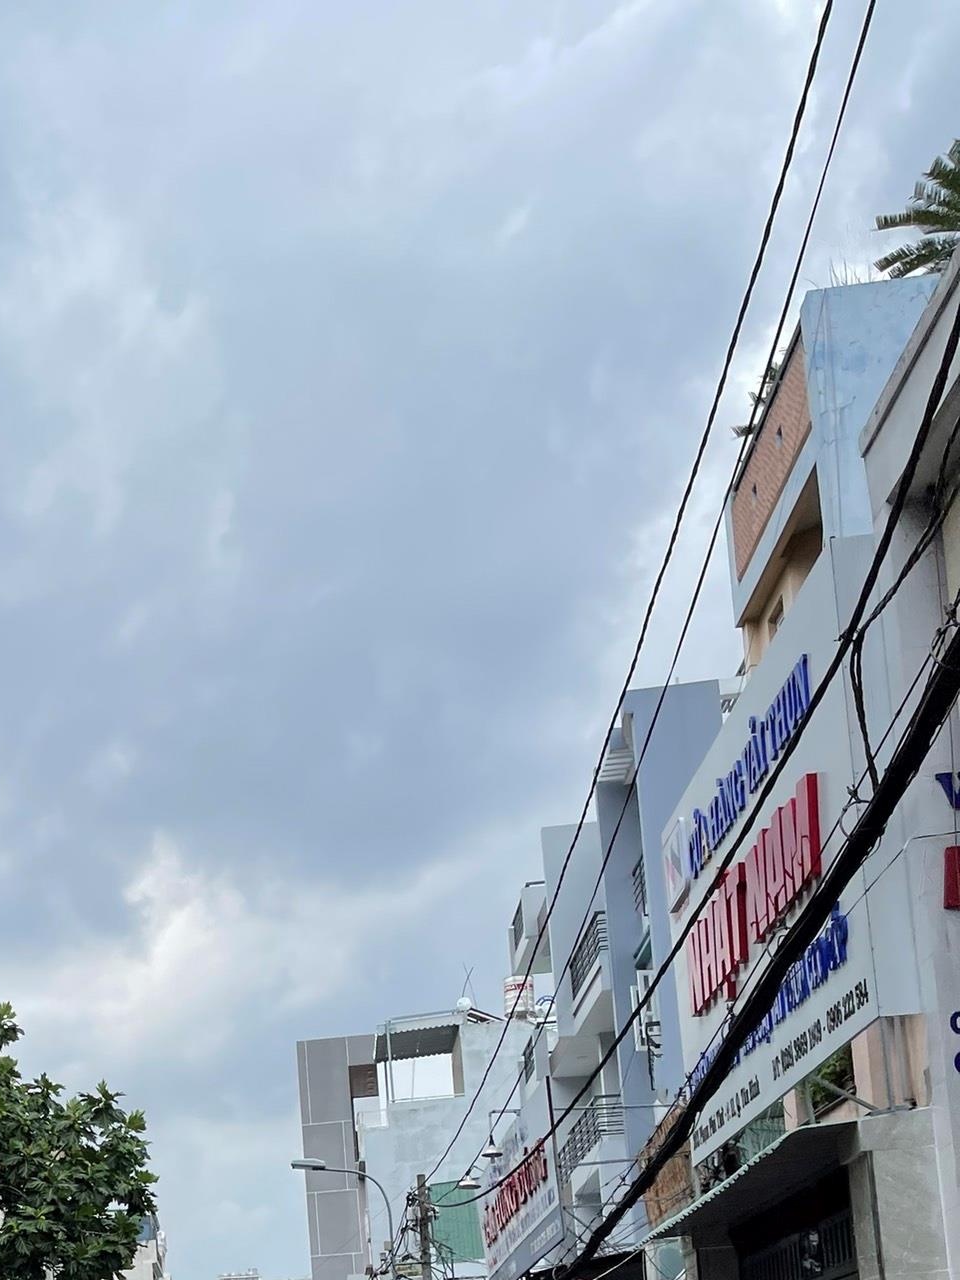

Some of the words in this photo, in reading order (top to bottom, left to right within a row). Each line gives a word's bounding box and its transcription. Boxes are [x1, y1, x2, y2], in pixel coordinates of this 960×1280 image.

[689, 808, 712, 879] CỬA
[708, 760, 747, 850] HÀNG
[742, 716, 769, 794] VẢI
[767, 654, 812, 761] THUN
[745, 773, 822, 943] NAM
